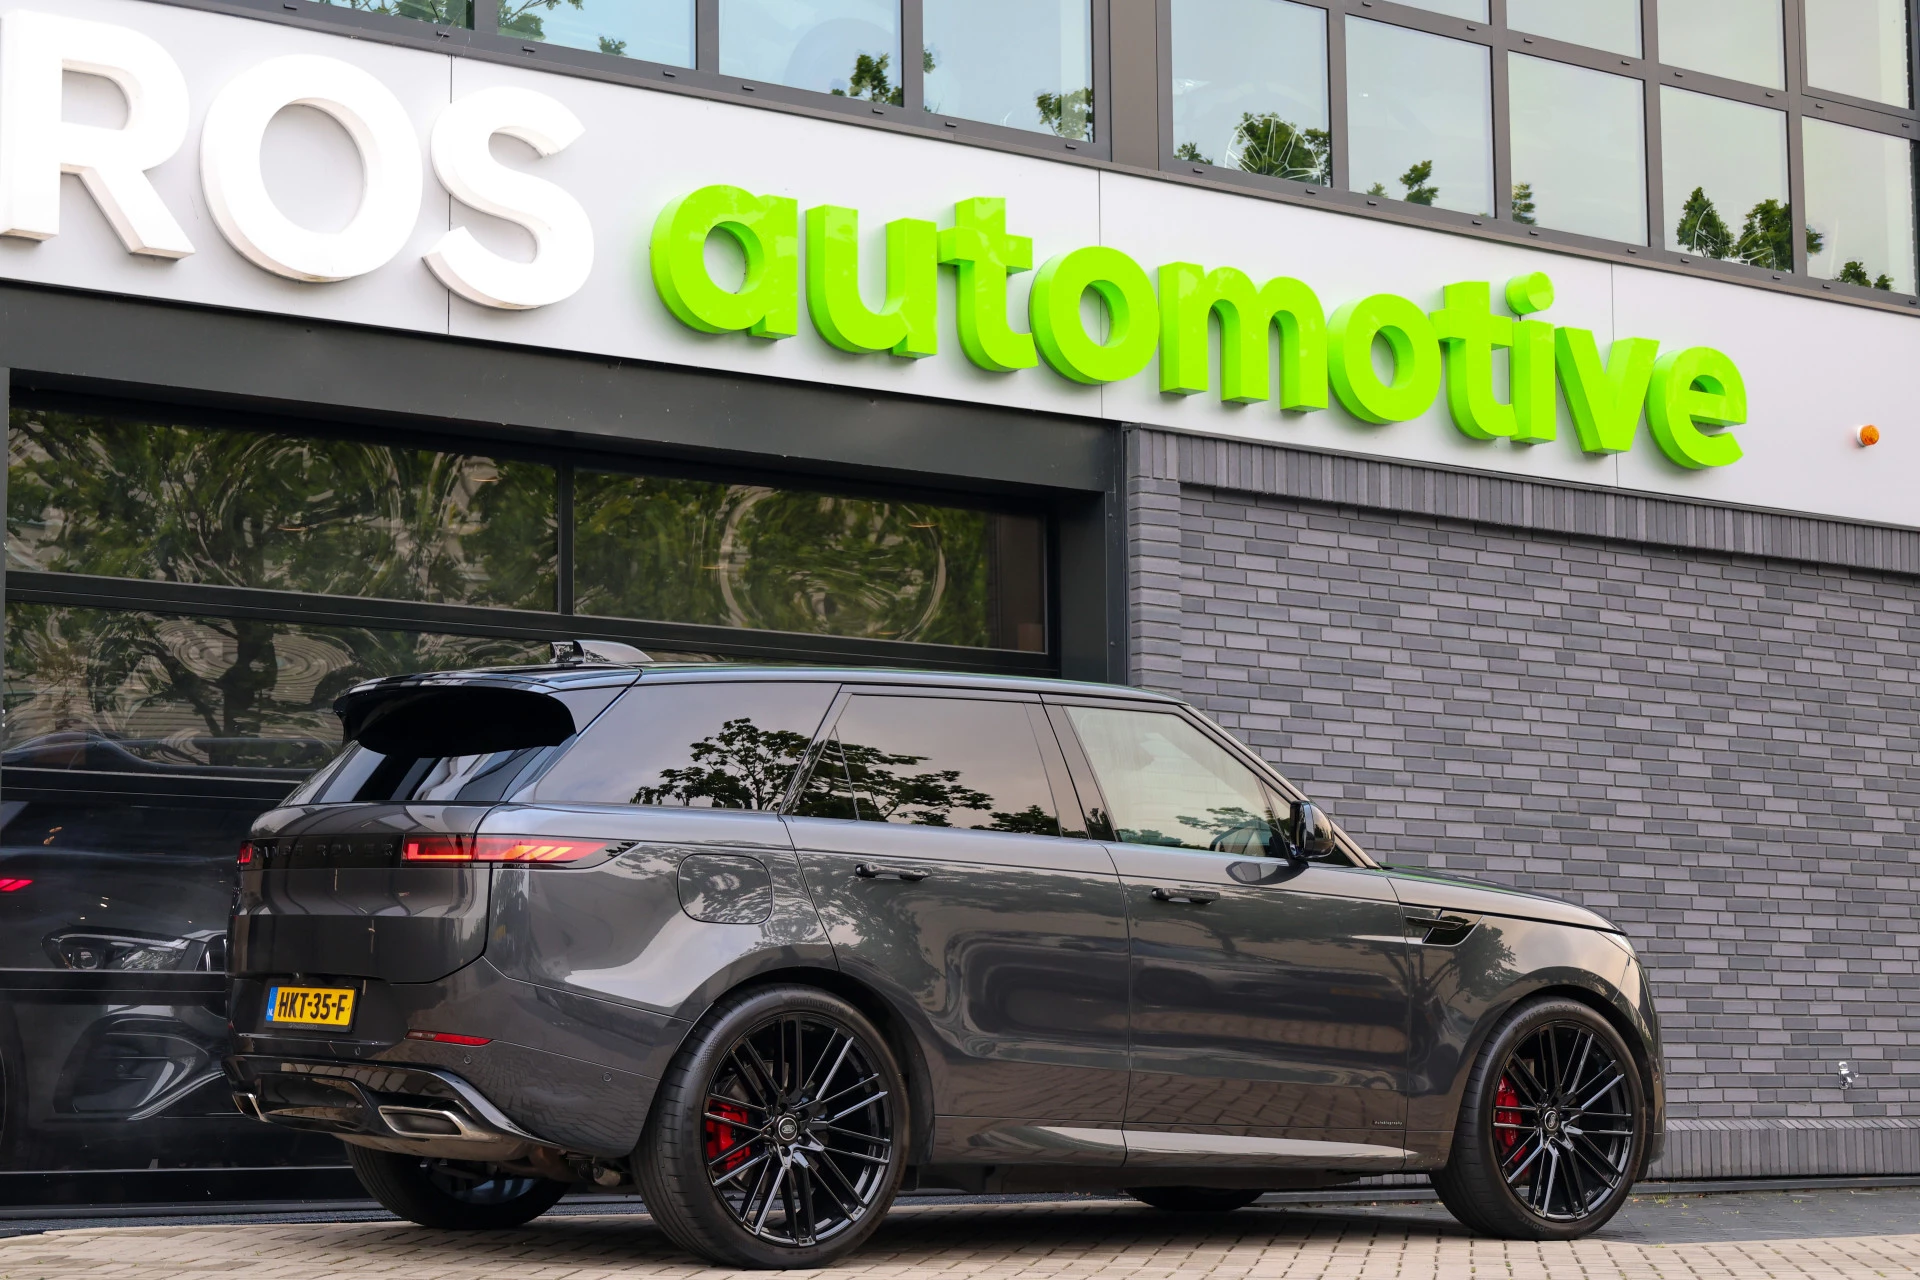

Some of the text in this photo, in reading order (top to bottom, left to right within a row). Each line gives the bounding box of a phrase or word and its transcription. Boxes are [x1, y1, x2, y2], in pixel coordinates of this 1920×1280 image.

[0, 8, 1748, 470] ROS automotive
[277, 991, 349, 1021] HKT-35-F
